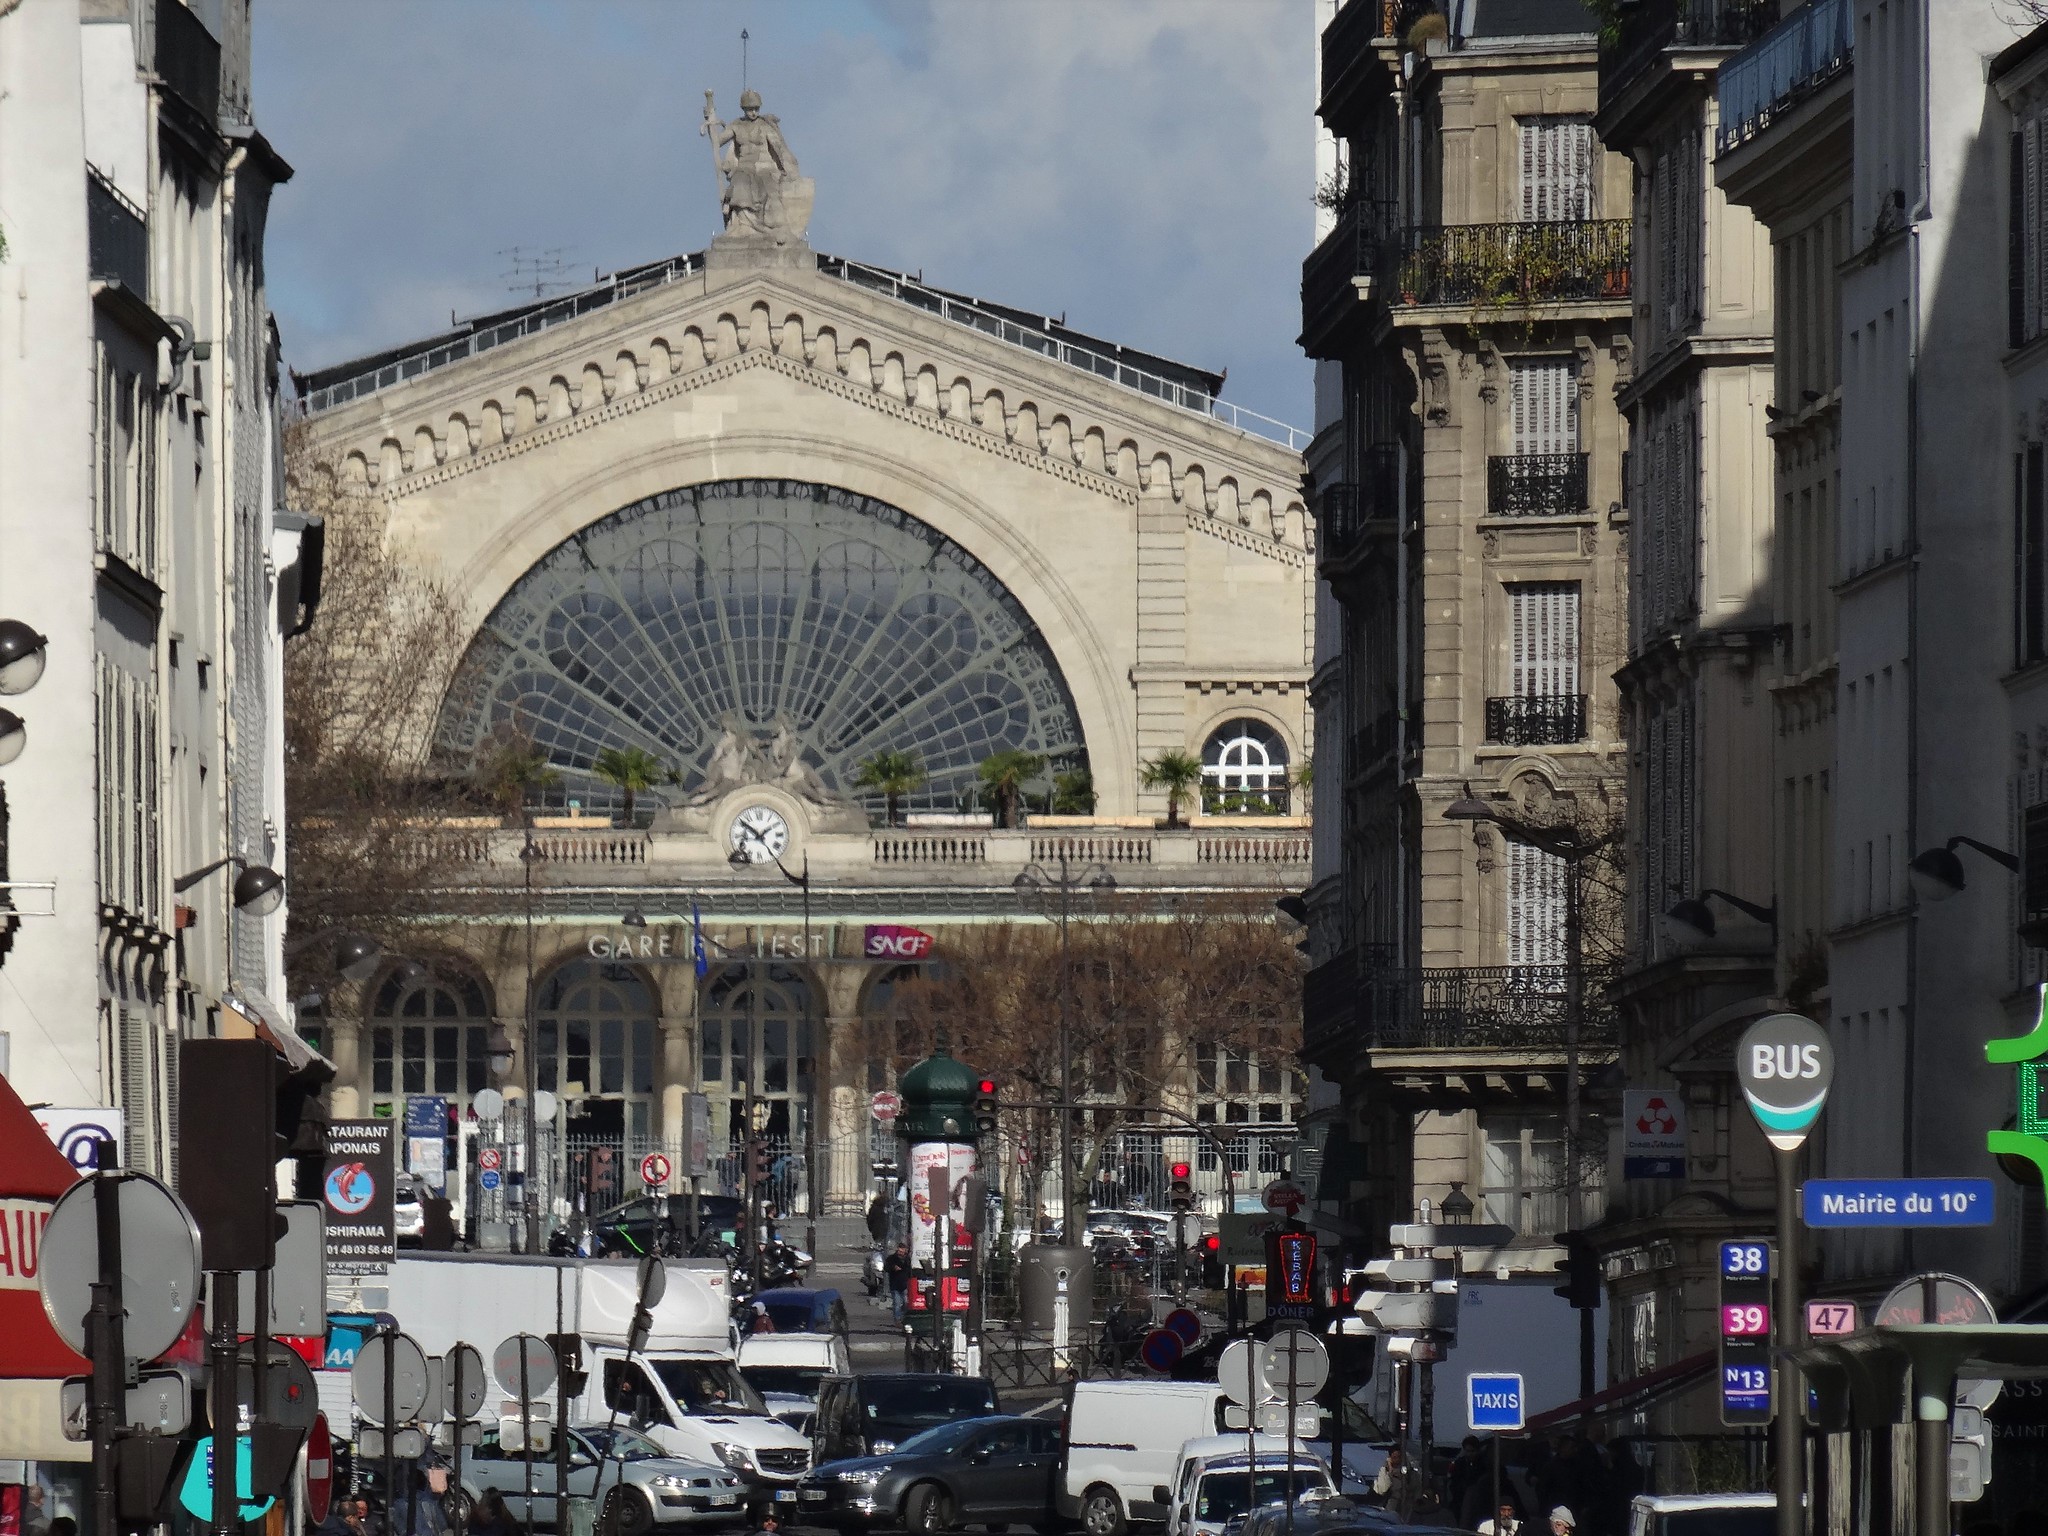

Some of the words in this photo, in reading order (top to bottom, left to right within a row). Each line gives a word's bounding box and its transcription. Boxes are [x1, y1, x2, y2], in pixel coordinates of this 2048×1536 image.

[588, 935, 671, 959] GARE
[866, 935, 928, 956] SNCF
[1752, 1044, 1821, 1079] BUS
[1822, 1193, 1897, 1214] Mairie
[1904, 1193, 1933, 1214] du
[1291, 1240, 1302, 1293] KEBAB
[1728, 1247, 1763, 1272] 38
[1267, 1304, 1315, 1318] DÖNER
[1729, 1307, 1764, 1333] 39
[1815, 1308, 1849, 1331] 47
[1727, 1368, 1766, 1389] N13
[1474, 1393, 1519, 1409] TAXIS
